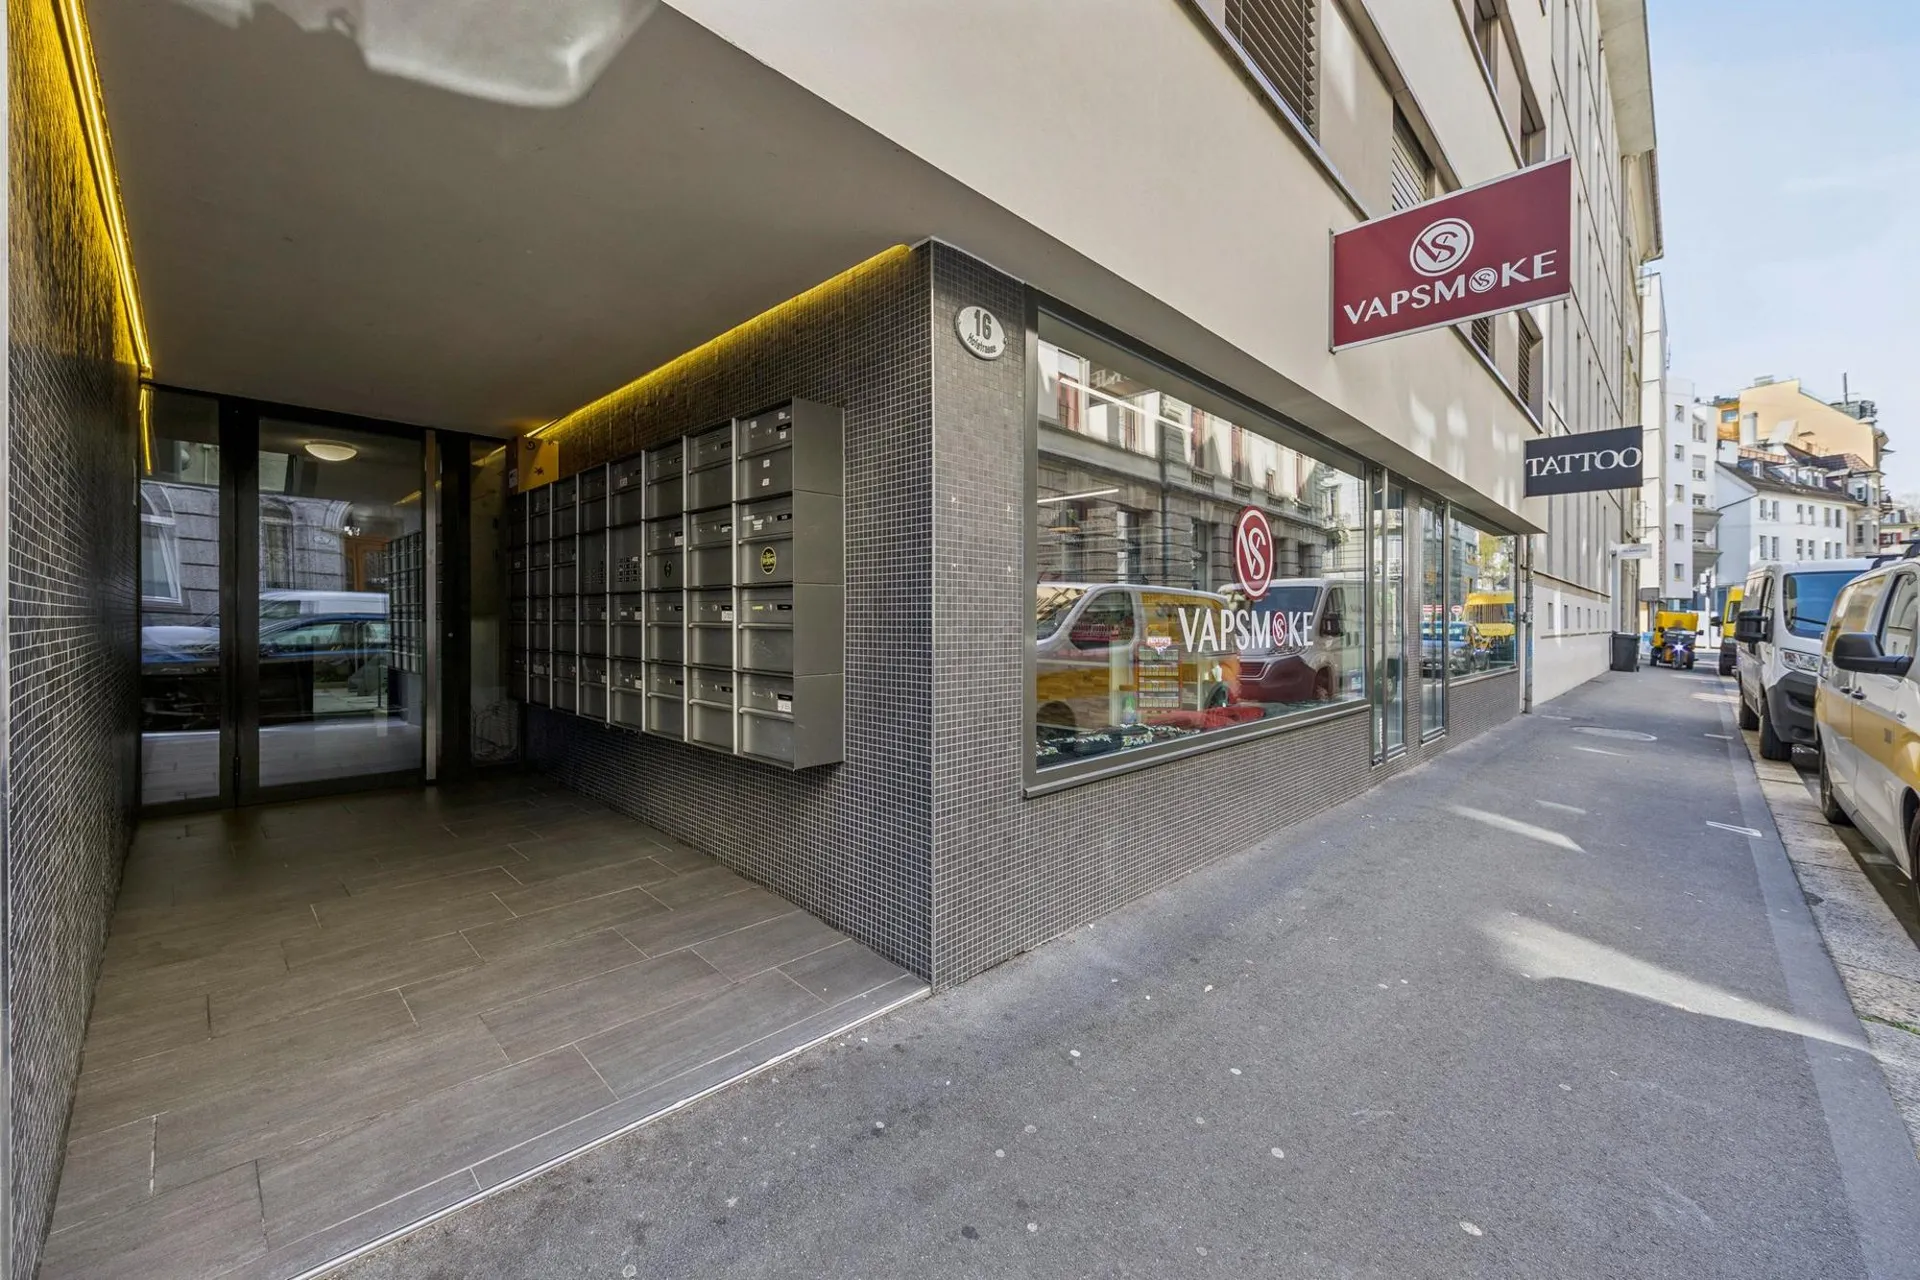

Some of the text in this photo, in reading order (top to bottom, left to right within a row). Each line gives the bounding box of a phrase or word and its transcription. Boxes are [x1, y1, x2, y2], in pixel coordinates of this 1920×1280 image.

[1343, 249, 1557, 325] VAPSMOKE
[974, 309, 992, 340] 16
[1526, 447, 1642, 477] TATTOO
[1177, 607, 1314, 653] VAPSMOKE
